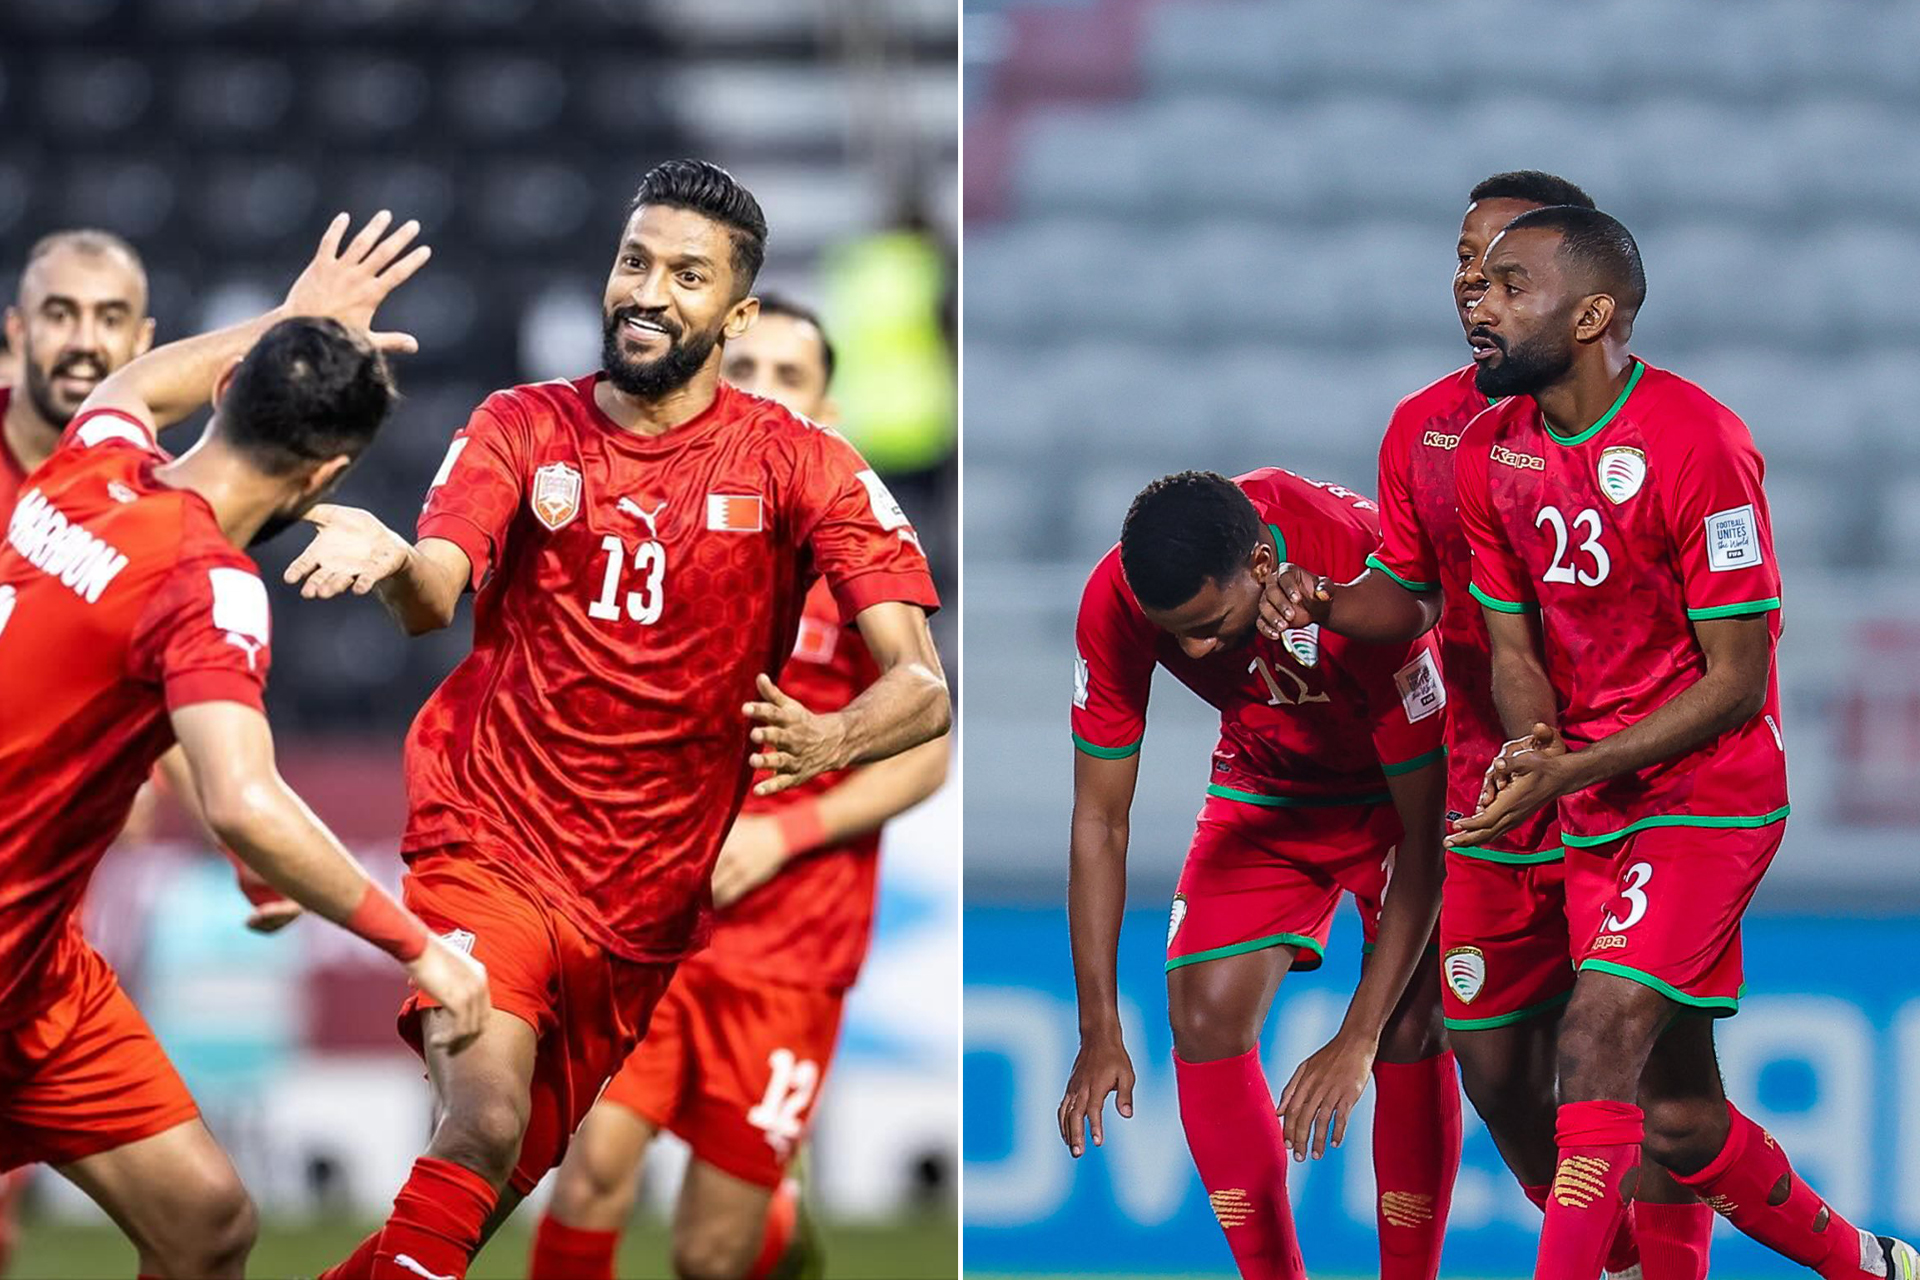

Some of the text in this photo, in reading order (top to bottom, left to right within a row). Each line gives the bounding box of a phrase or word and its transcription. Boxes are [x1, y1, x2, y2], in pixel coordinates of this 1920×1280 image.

[1534, 505, 1611, 588] 23
[1716, 518, 1745, 530] FOOTBALL
[1717, 526, 1747, 540] UNITES
[587, 534, 666, 625] 13
[1247, 656, 1331, 706] 12
[1600, 862, 1653, 932] 3
